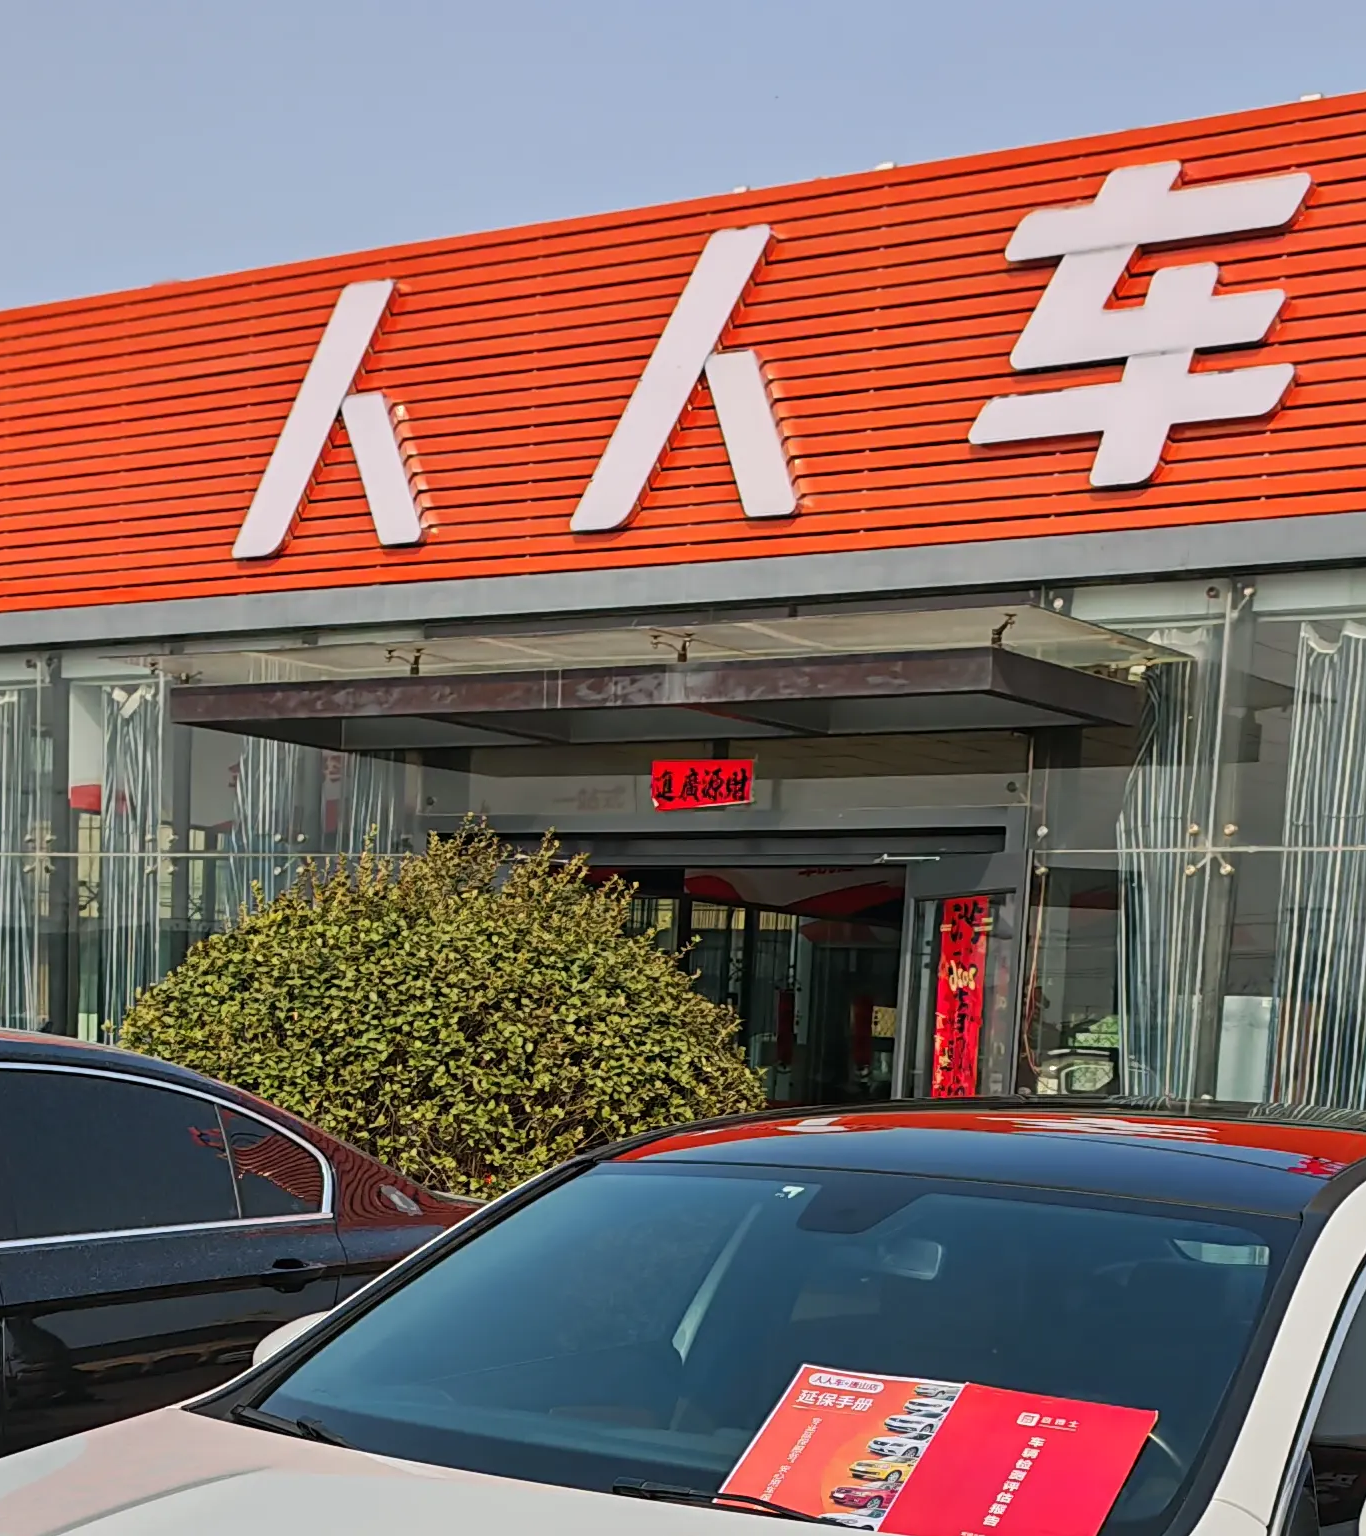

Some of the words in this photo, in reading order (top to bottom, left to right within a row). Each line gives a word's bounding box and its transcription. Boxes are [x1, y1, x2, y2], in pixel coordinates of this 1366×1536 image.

[231, 160, 1315, 560] 人人车
[796, 1389, 874, 1412] 延保手册
[981, 1436, 1047, 1527] 车辆检测评估报告
